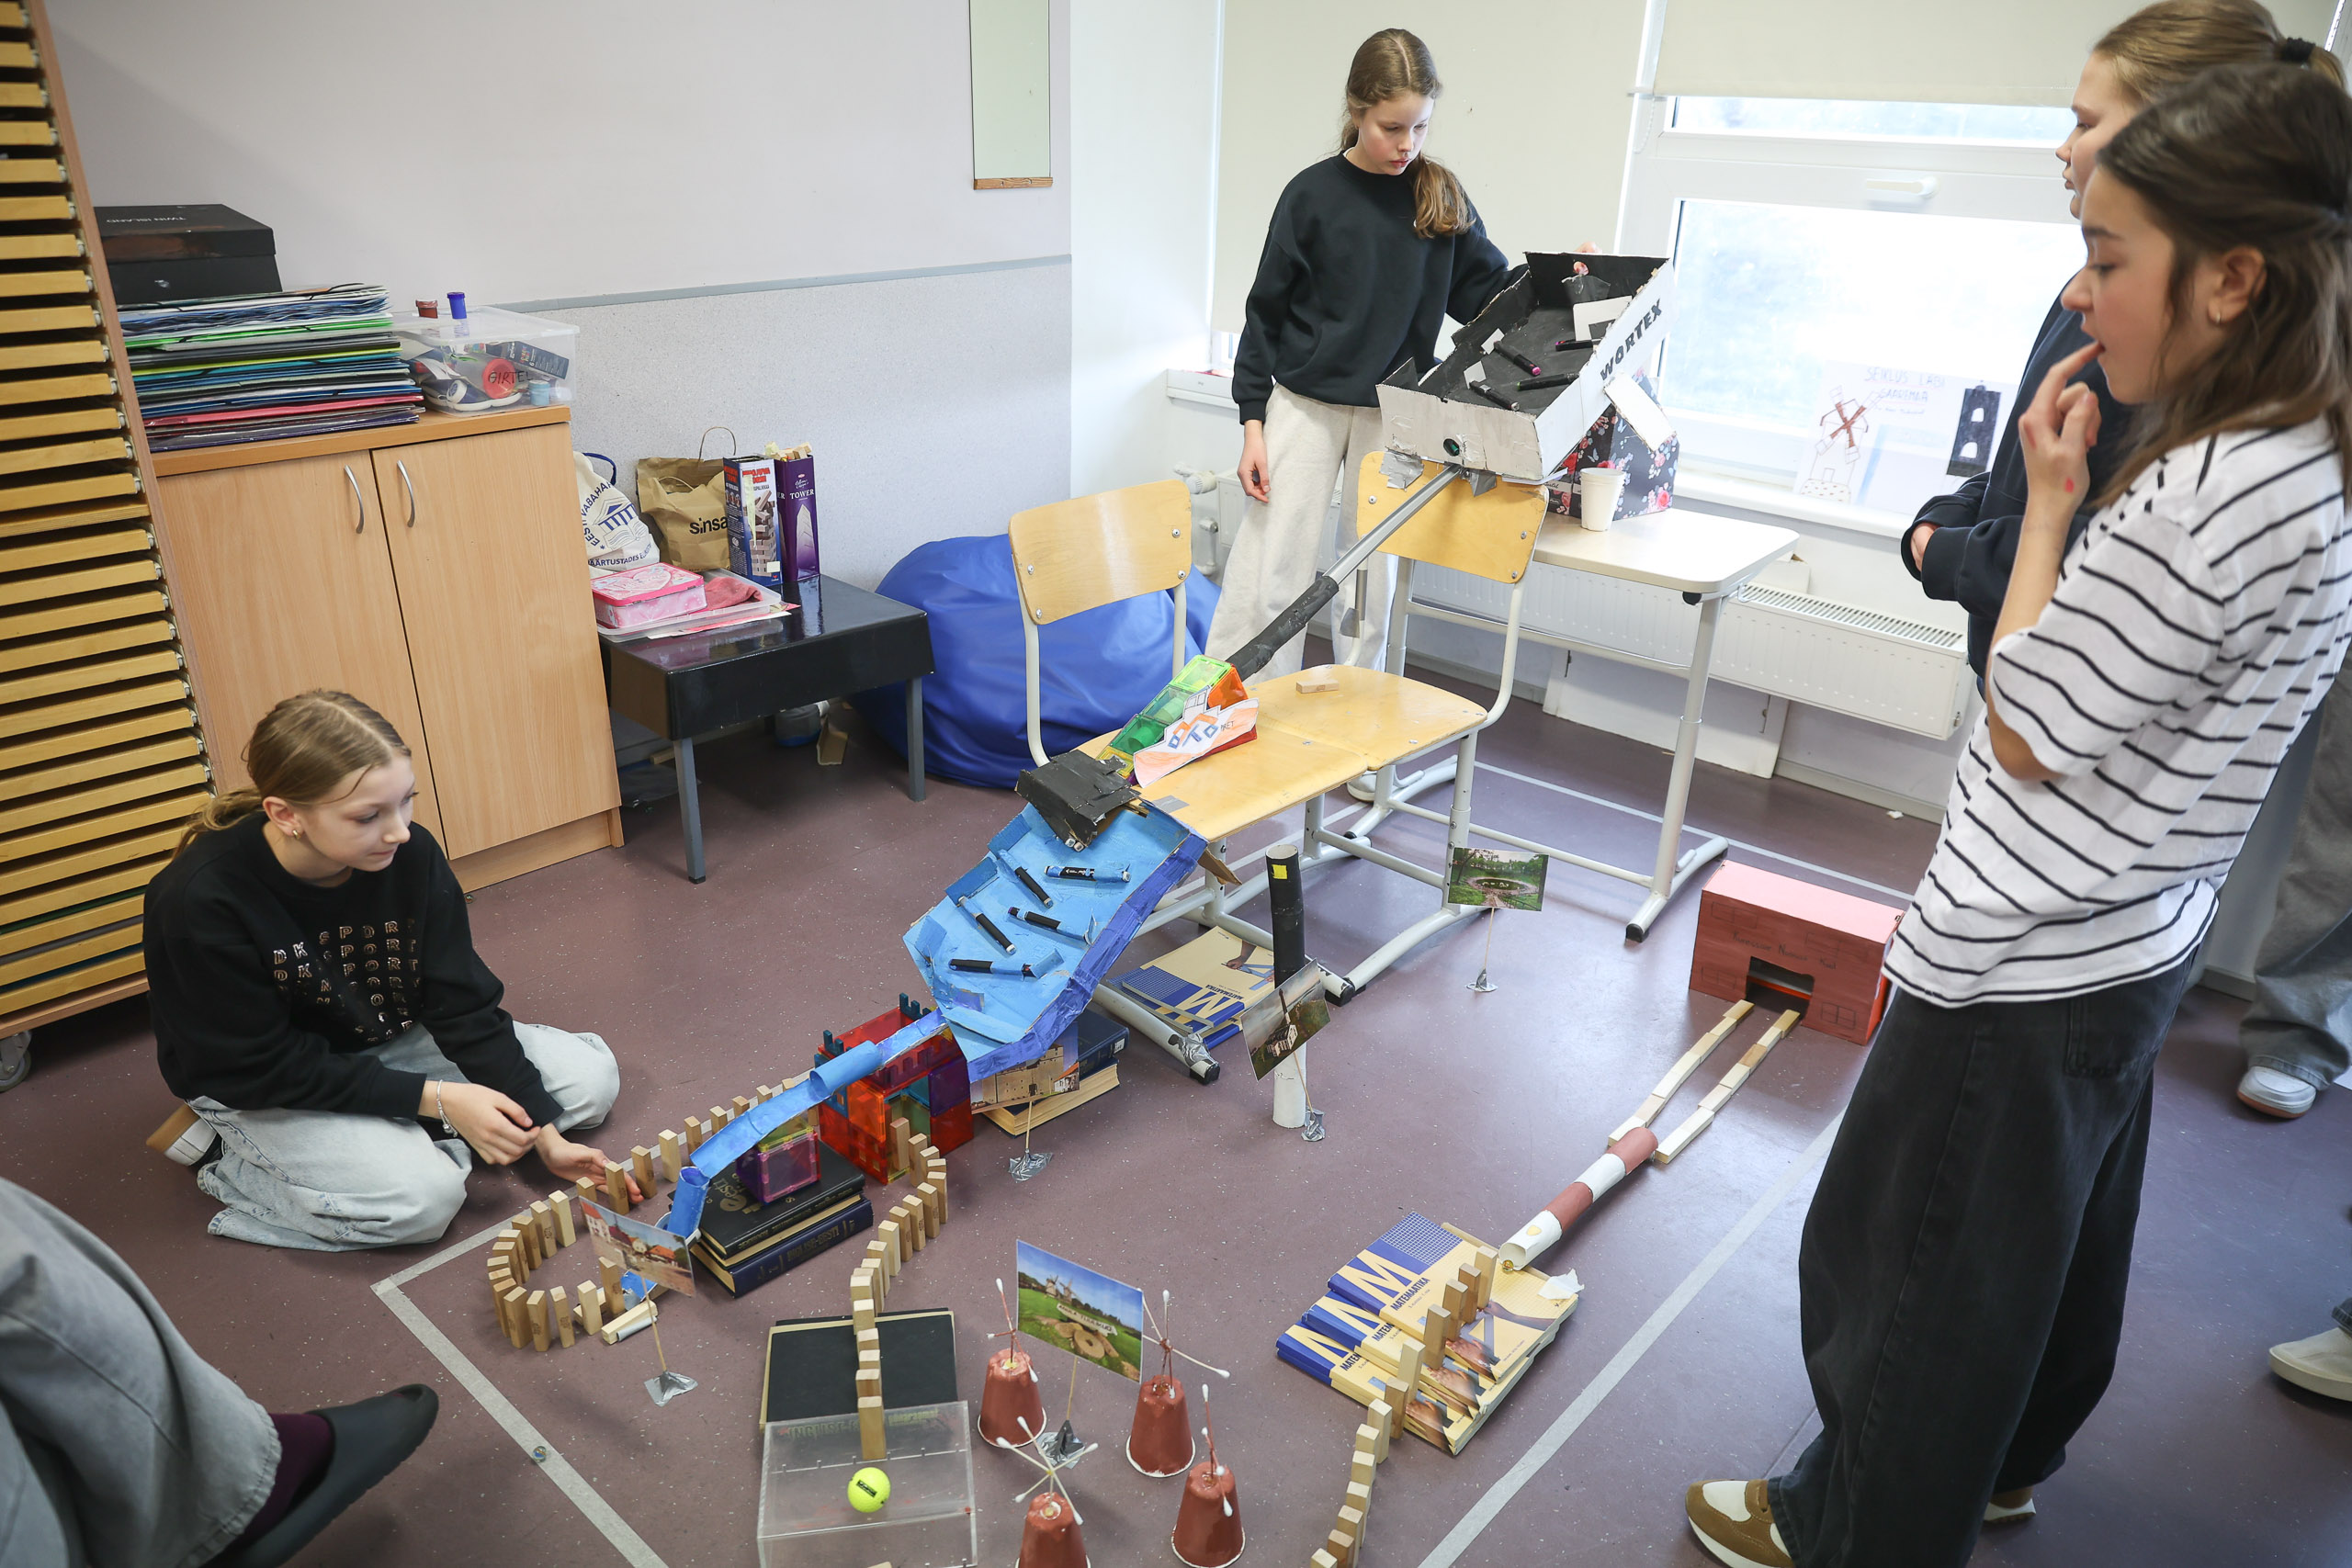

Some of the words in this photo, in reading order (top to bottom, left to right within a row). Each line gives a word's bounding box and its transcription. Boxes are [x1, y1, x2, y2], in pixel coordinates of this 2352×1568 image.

[1600, 298, 1663, 381] WORTEX
[789, 489, 815, 500] TOWER
[689, 516, 729, 535] sinsa
[1390, 1277, 1430, 1312] MATEMAATIKA
